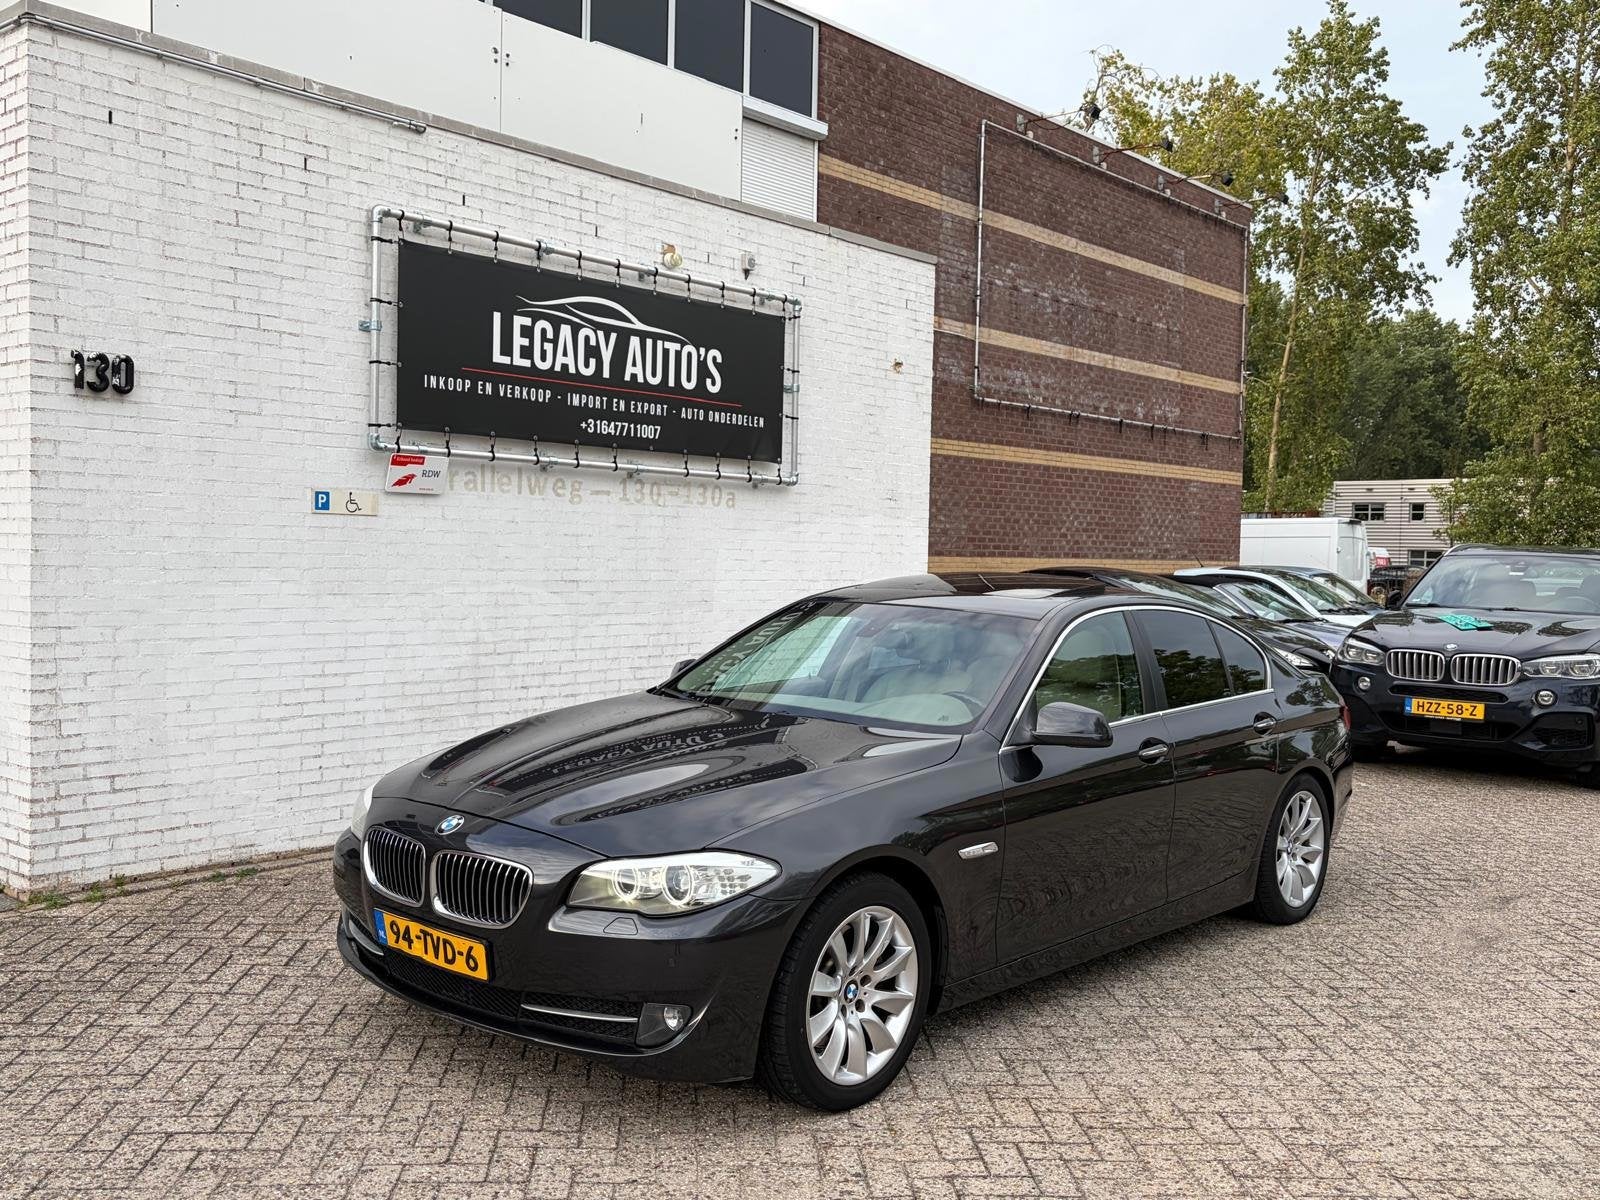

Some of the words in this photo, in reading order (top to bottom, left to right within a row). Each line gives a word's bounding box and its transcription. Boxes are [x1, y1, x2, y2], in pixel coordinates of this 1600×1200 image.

[492, 311, 617, 379] LEGACY
[624, 335, 723, 393] AUTO'S
[71, 350, 135, 394] 130
[424, 374, 471, 393] INKOOP
[478, 381, 492, 396] EN
[499, 383, 552, 403] VERKOOP
[568, 392, 608, 410] IMPORT
[613, 398, 625, 413] EN
[630, 402, 668, 417] EXPORT
[681, 407, 704, 421] AUTO
[708, 411, 765, 428] ONDERDELEN
[580, 419, 661, 439] +31647711007
[421, 469, 441, 478] RDW
[319, 494, 327, 507] P
[1416, 700, 1478, 717] HZZ-58-Z
[390, 919, 479, 973] 94-TVD-6
